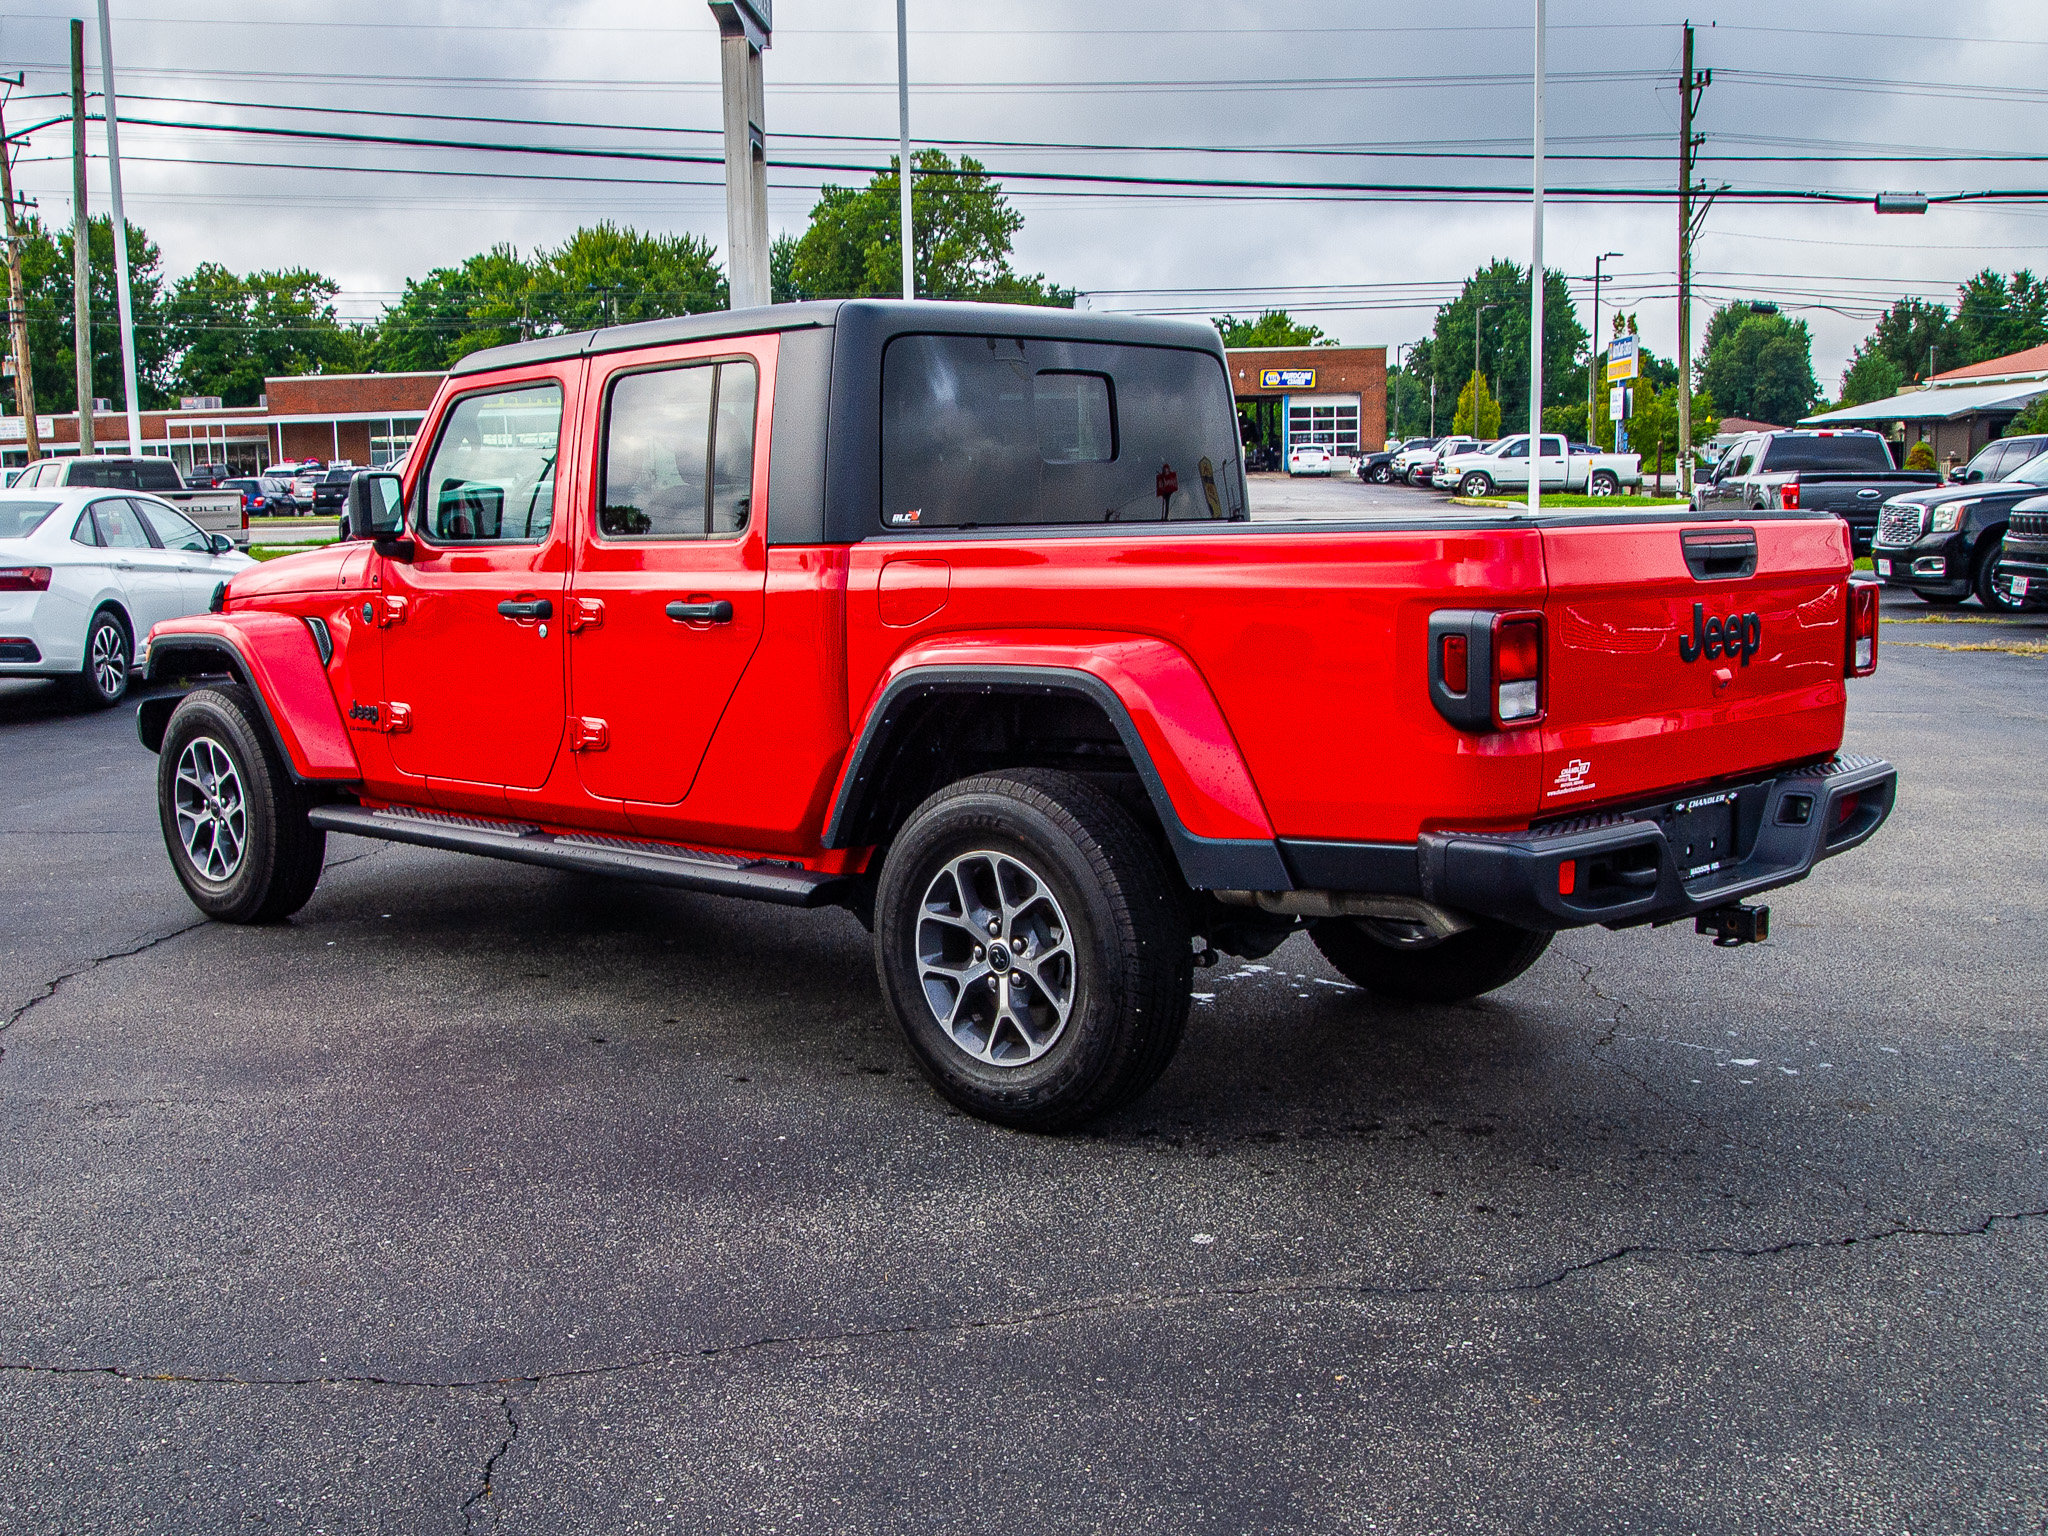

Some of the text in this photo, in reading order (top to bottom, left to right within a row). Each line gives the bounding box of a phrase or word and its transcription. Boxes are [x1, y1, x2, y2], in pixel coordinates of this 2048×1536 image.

[179, 504, 233, 513] ROLET
[1680, 603, 1761, 668] Jeep
[349, 699, 379, 725] Jeep
[1688, 794, 1726, 809] CHANDLER
